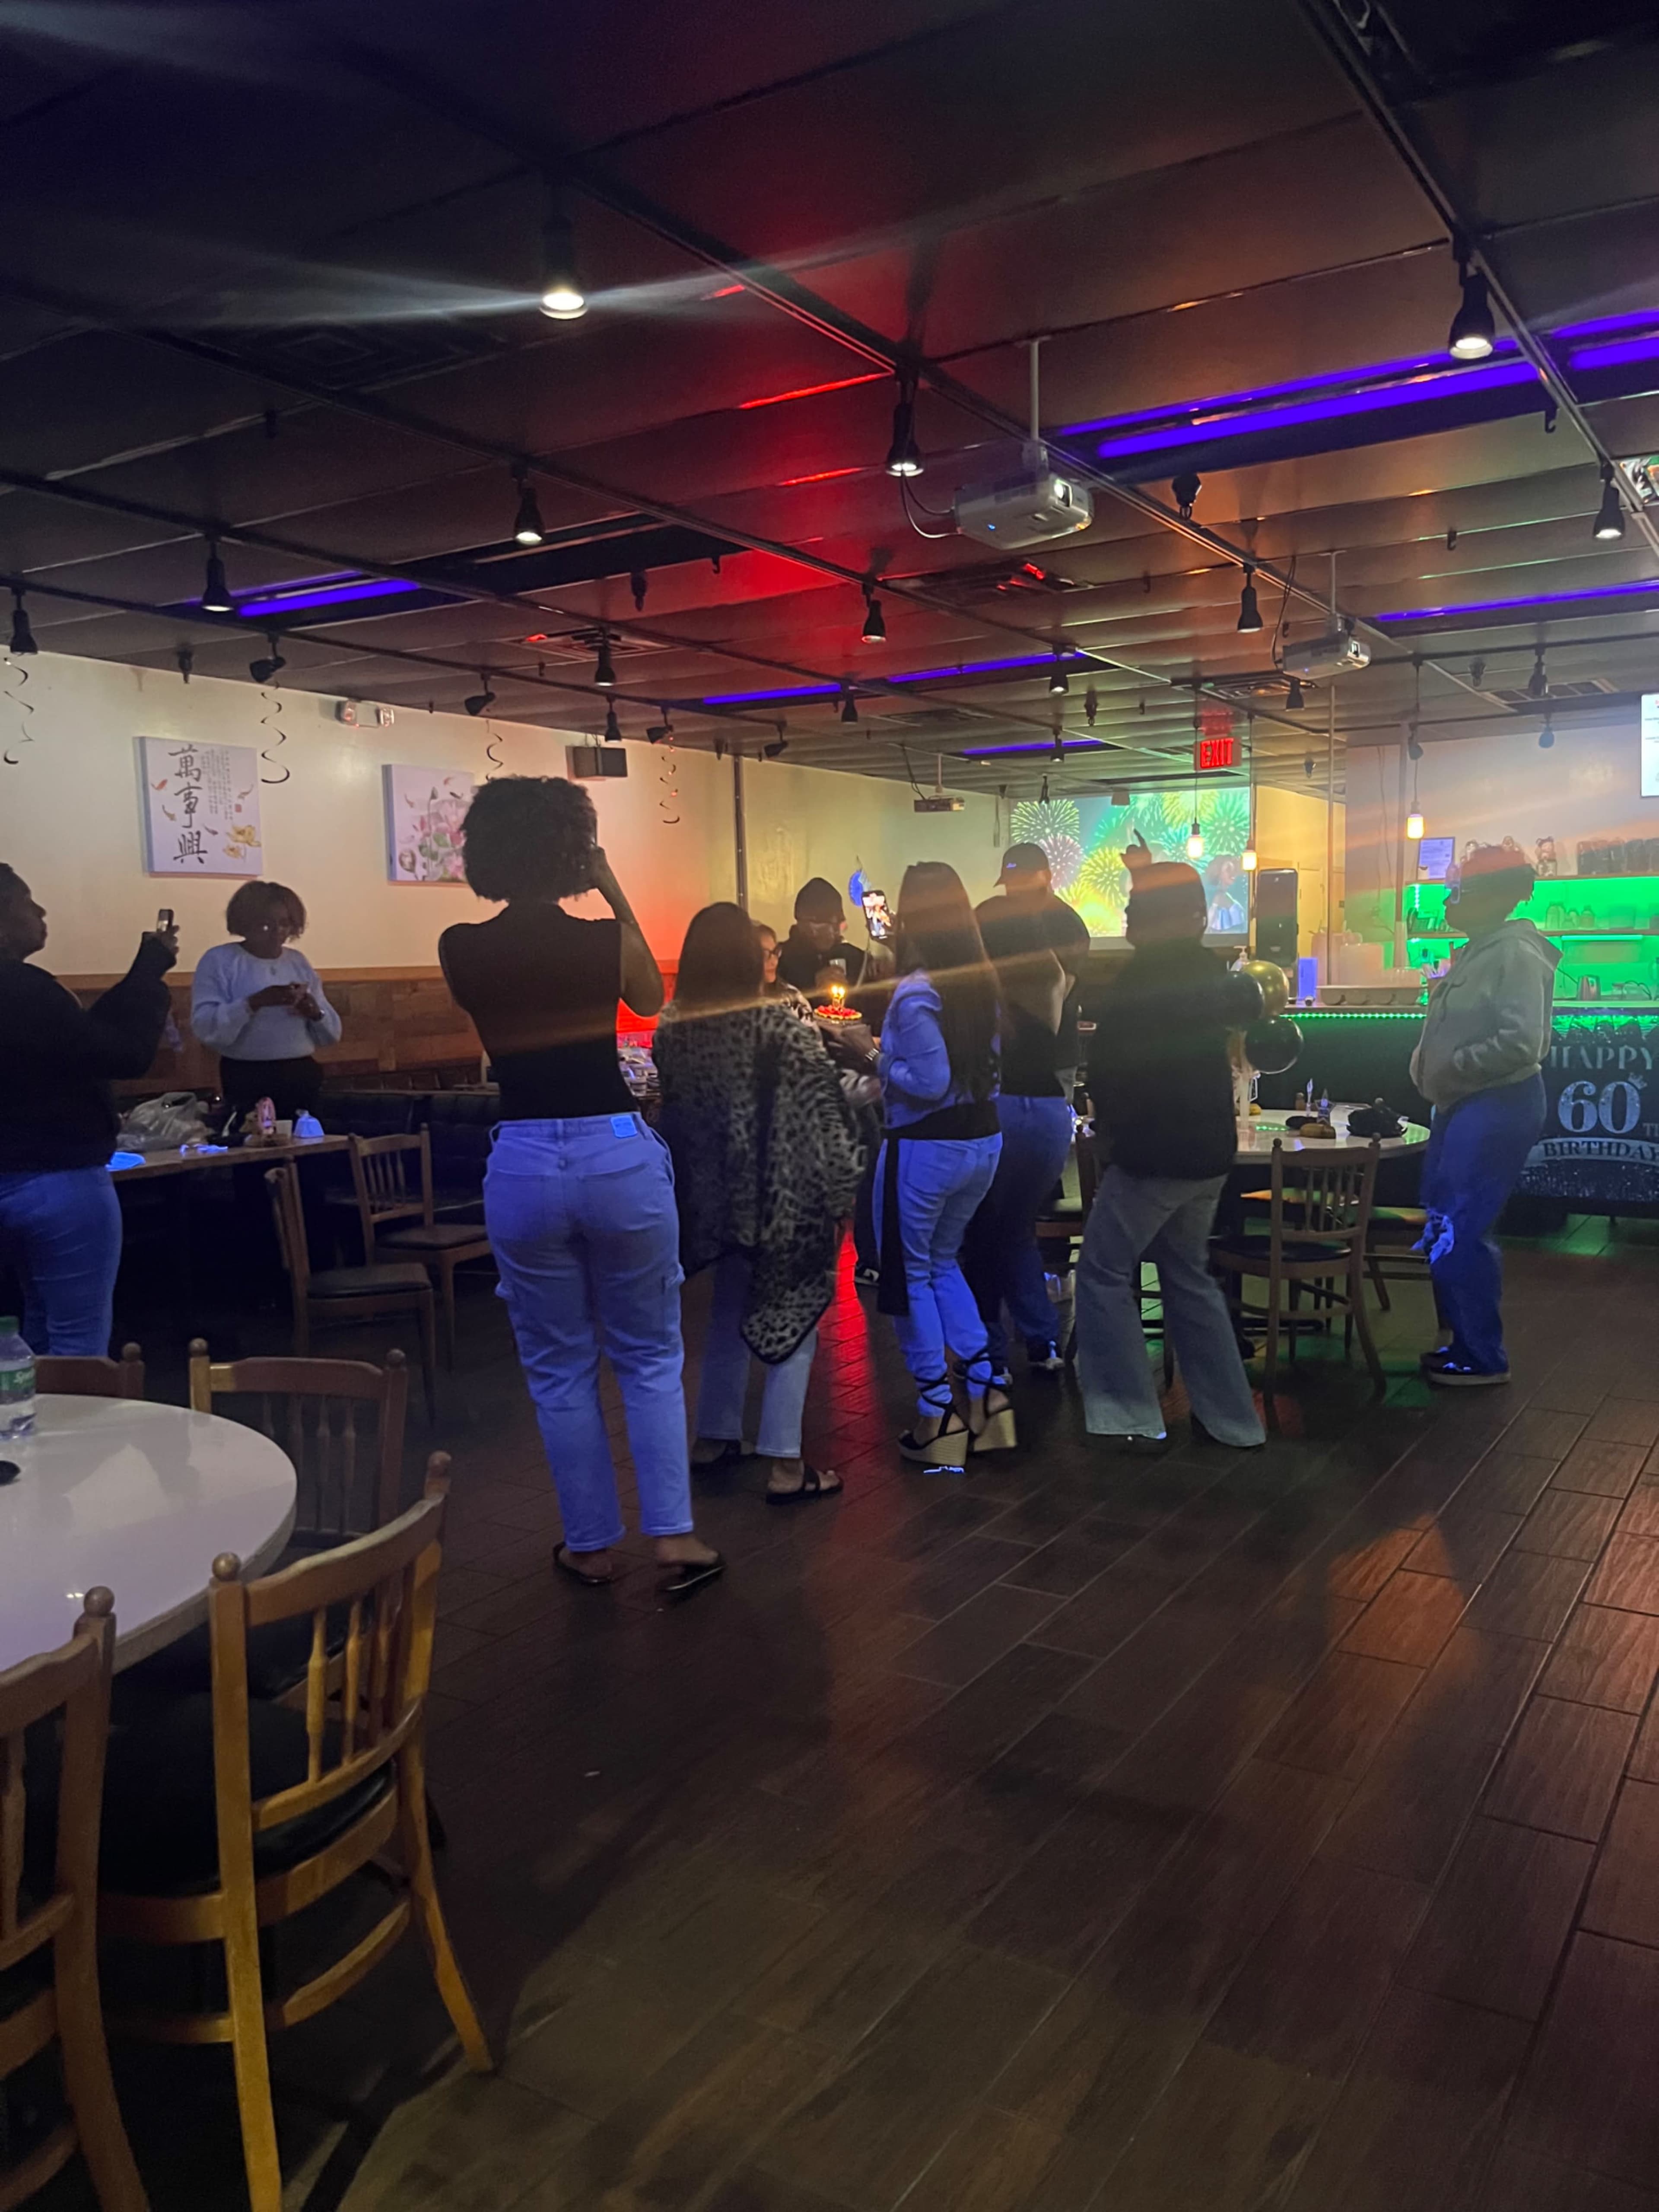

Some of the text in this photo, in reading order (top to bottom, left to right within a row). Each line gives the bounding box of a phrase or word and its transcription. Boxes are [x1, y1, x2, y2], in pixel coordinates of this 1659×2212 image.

[1201, 738, 1233, 768] EXIT
[1550, 1044, 1653, 1070] HAPPY
[1557, 1081, 1640, 1134] 60
